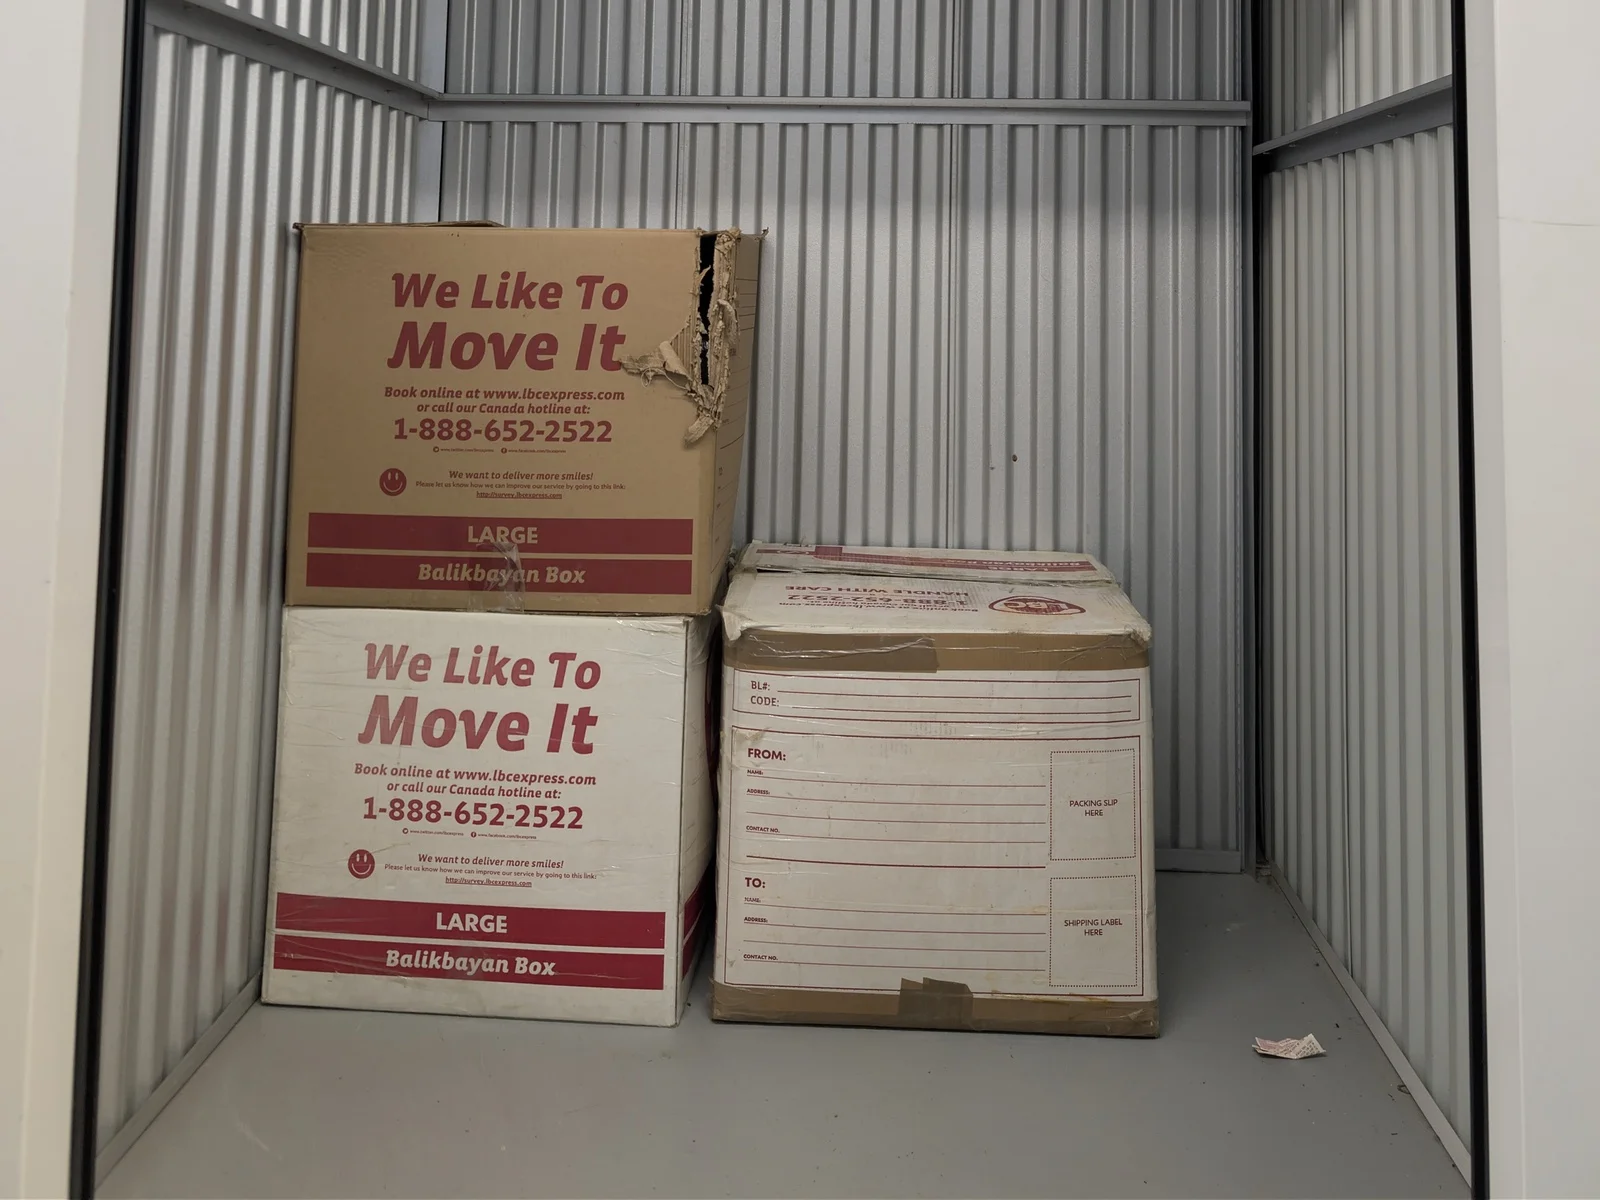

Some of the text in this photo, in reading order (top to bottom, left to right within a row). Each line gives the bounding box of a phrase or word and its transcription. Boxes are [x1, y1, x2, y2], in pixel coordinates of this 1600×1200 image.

[391, 270, 629, 311] We Like To
[386, 320, 627, 372] Move It
[384, 386, 625, 402] Book online at www.lbcexpress.com
[416, 403, 591, 415] or call our Canada hotline at:
[394, 418, 612, 442] 1-888-652-2522
[449, 470, 593, 481] We want to deliver more smiles!
[565, 482, 573, 490] by
[467, 525, 538, 544] LARGE
[418, 564, 586, 586] Balikbayan Box
[893, 589, 969, 597] HANDLE
[365, 642, 601, 690] We Like To
[751, 680, 771, 691] BL#:
[750, 695, 779, 707] CODE:
[358, 694, 599, 755] Move It
[747, 747, 786, 761] FROM:
[354, 763, 597, 786] Book online at www.lbcexpress.com
[387, 782, 561, 799] or call our Canada hotline at:
[363, 797, 583, 829] 1-888-652-2522
[1084, 809, 1103, 817] HERE
[418, 854, 433, 863] We
[434, 856, 459, 865] want
[460, 857, 471, 865] to
[472, 856, 504, 867] deliver
[531, 859, 564, 869] smiles!
[445, 876, 532, 886] http://survey.lbcexpress.com
[476, 868, 500, 876] improve
[535, 870, 543, 879] by
[544, 872, 563, 880] going
[583, 872, 597, 880] link:
[744, 877, 766, 889] TO:
[436, 912, 508, 934] LARGE
[1100, 918, 1123, 926] LABEL
[1084, 928, 1103, 936] HERE
[386, 950, 556, 976] Balikbayan Box
